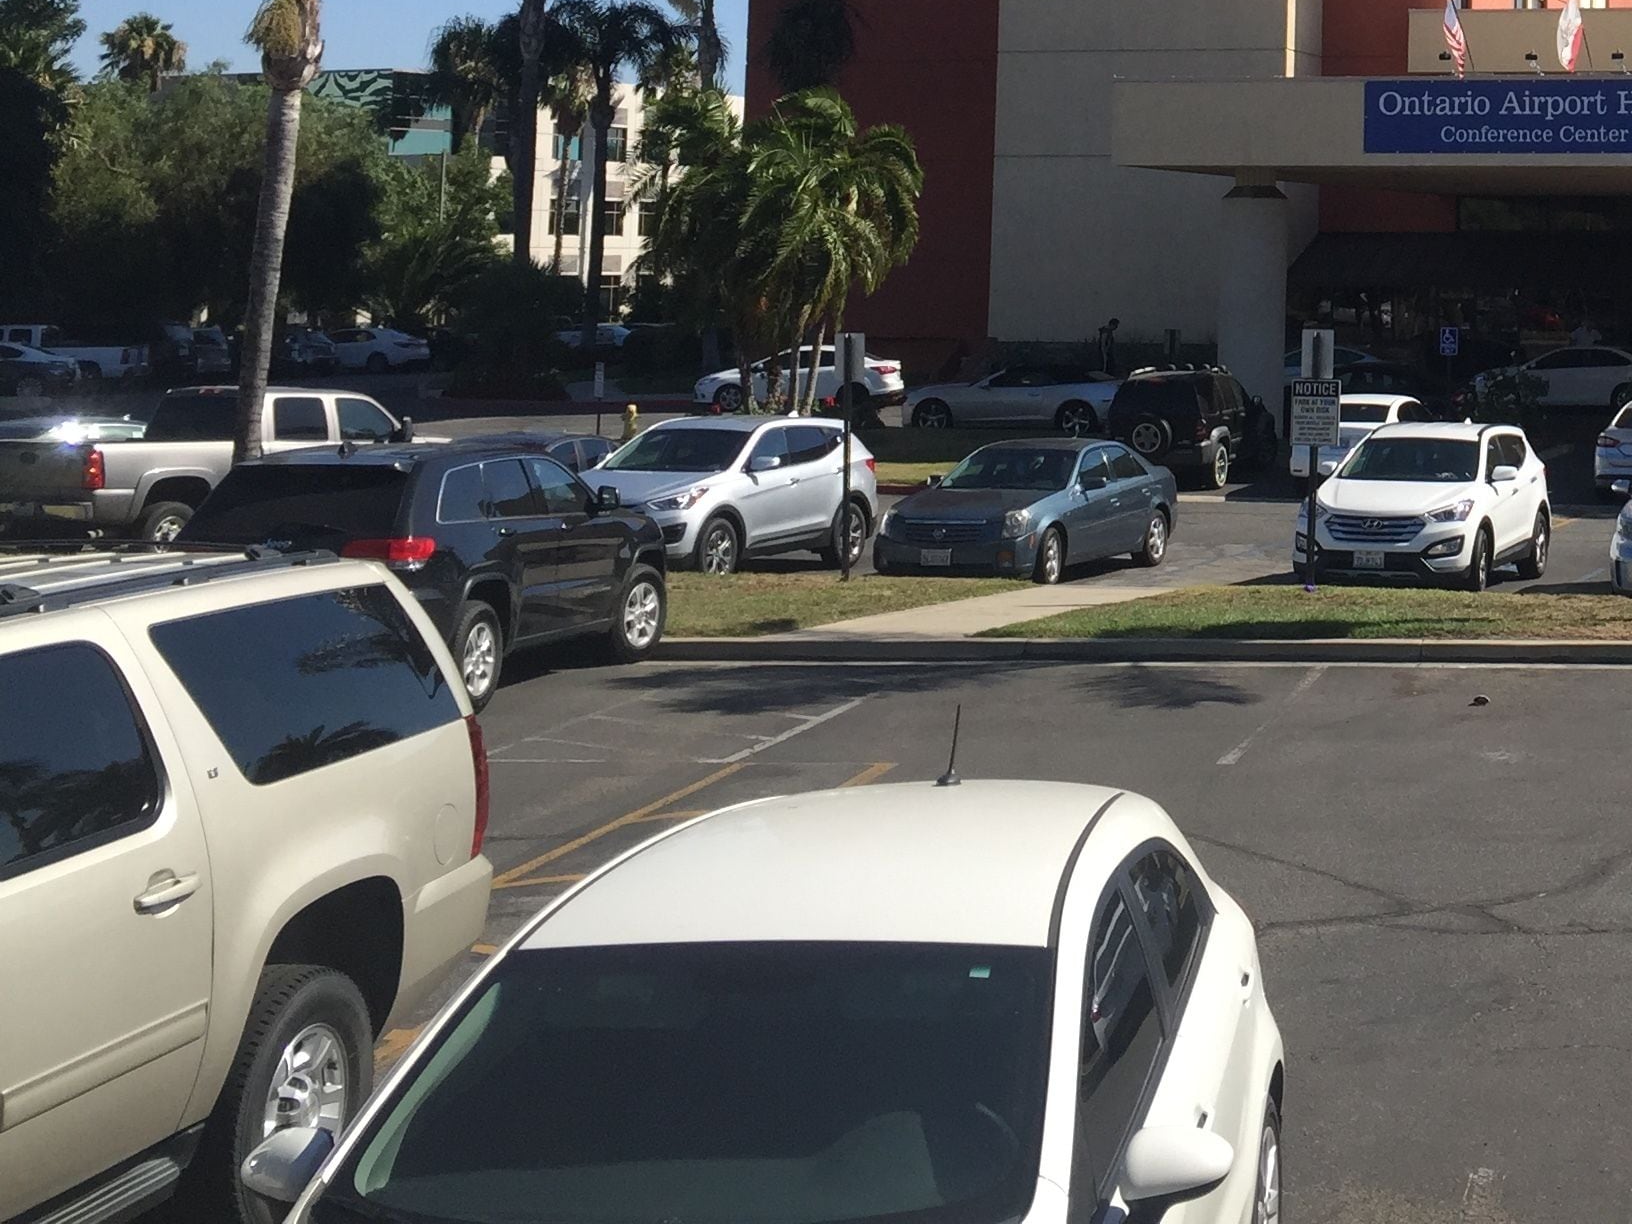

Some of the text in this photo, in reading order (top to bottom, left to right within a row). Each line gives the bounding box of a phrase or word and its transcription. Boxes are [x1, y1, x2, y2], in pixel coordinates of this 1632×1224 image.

[1378, 89, 1490, 116] Ontario
[1499, 89, 1607, 120] Airport
[1440, 125, 1629, 143] Conference Center
[1295, 383, 1336, 395] NOTICE
